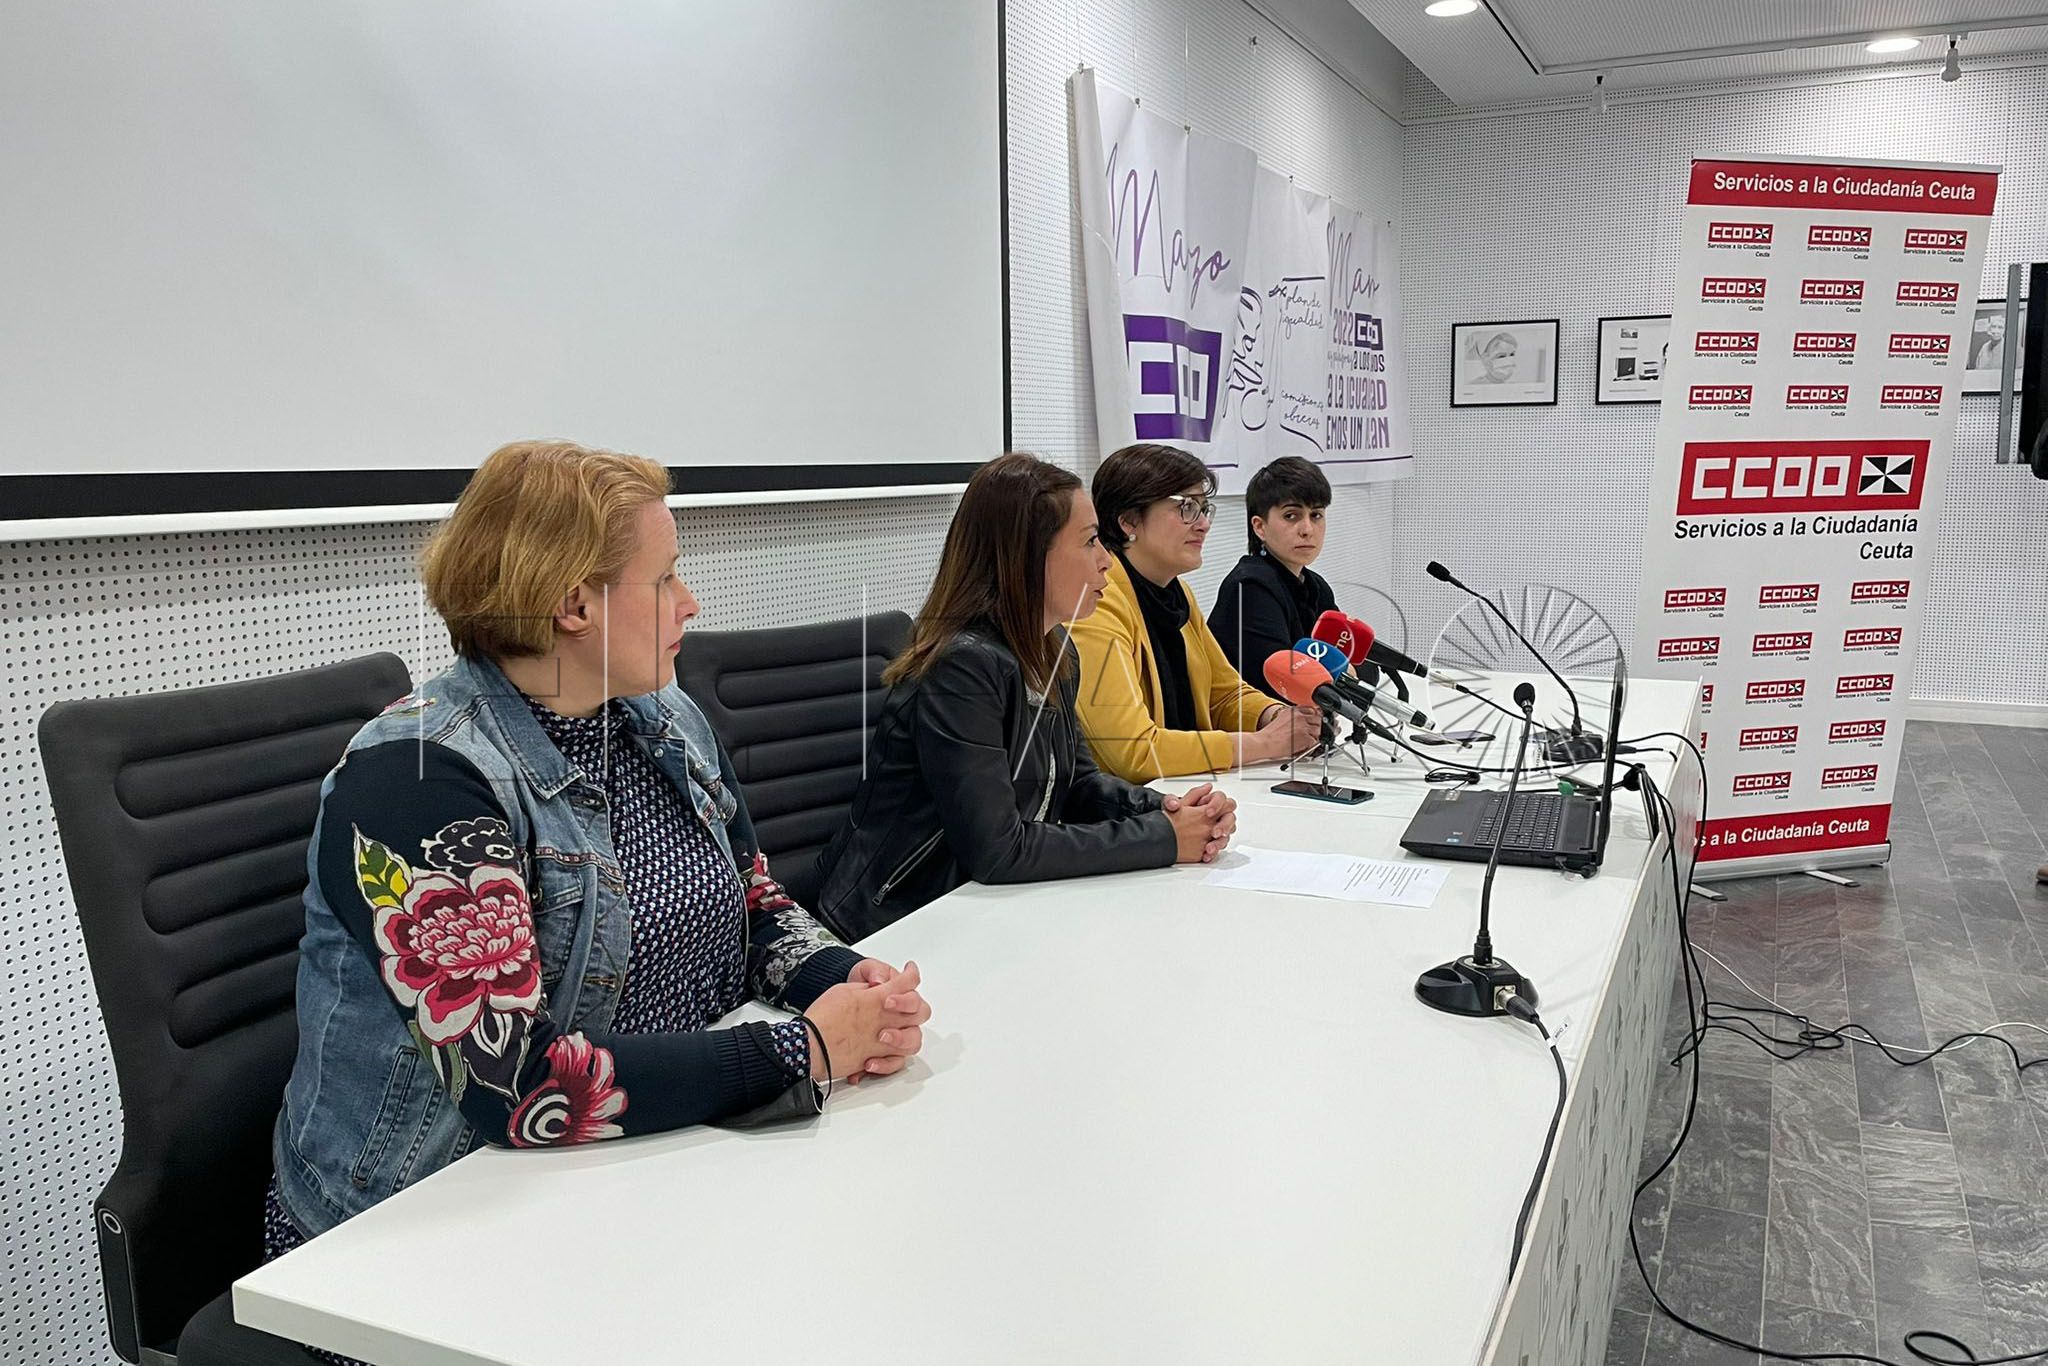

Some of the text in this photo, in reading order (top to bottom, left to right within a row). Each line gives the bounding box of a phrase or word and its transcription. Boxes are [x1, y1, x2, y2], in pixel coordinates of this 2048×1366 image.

[1713, 172, 1976, 200] Servicios a la Ciudadanía Ceuta
[1106, 143, 1231, 310] Mayo
[1711, 226, 1754, 240] CCOO
[1810, 229, 1853, 242] CCOO
[1907, 232, 1949, 246] CCOO
[1704, 281, 1747, 294] CCOO
[1803, 283, 1845, 296] CCOO
[1899, 285, 1940, 298] CCOO
[1698, 335, 1740, 348] CCOO
[1796, 336, 1837, 348] CCOO
[1891, 337, 1932, 349] CCOO
[1691, 389, 1733, 401] CCOO
[1789, 389, 1830, 400] CCOO
[1883, 389, 1924, 400] CCOO
[1691, 455, 1852, 500] CCOO
[1674, 514, 1919, 540] Servicios a la Ciudadanía
[1859, 540, 1914, 560] Ceuta
[1761, 588, 1801, 600] CCOO
[1853, 584, 1892, 596] CCOO
[1666, 591, 1707, 605] CCOO
[1755, 636, 1795, 649] CCOO
[1846, 631, 1884, 644] CCOO
[1660, 640, 1701, 654] CCOO
[1748, 683, 1787, 696] CCOO
[1838, 678, 1876, 691] CCOO
[1832, 723, 1869, 736] CCOO
[1742, 730, 1781, 743] CCOO
[1824, 768, 1861, 782] CCOO
[1735, 776, 1774, 789] CCOO
[1710, 834, 1720, 846] a
[1723, 830, 1737, 845] la
[1741, 822, 1824, 843] Ciudadanía
[1828, 819, 1870, 834] Ceuta
